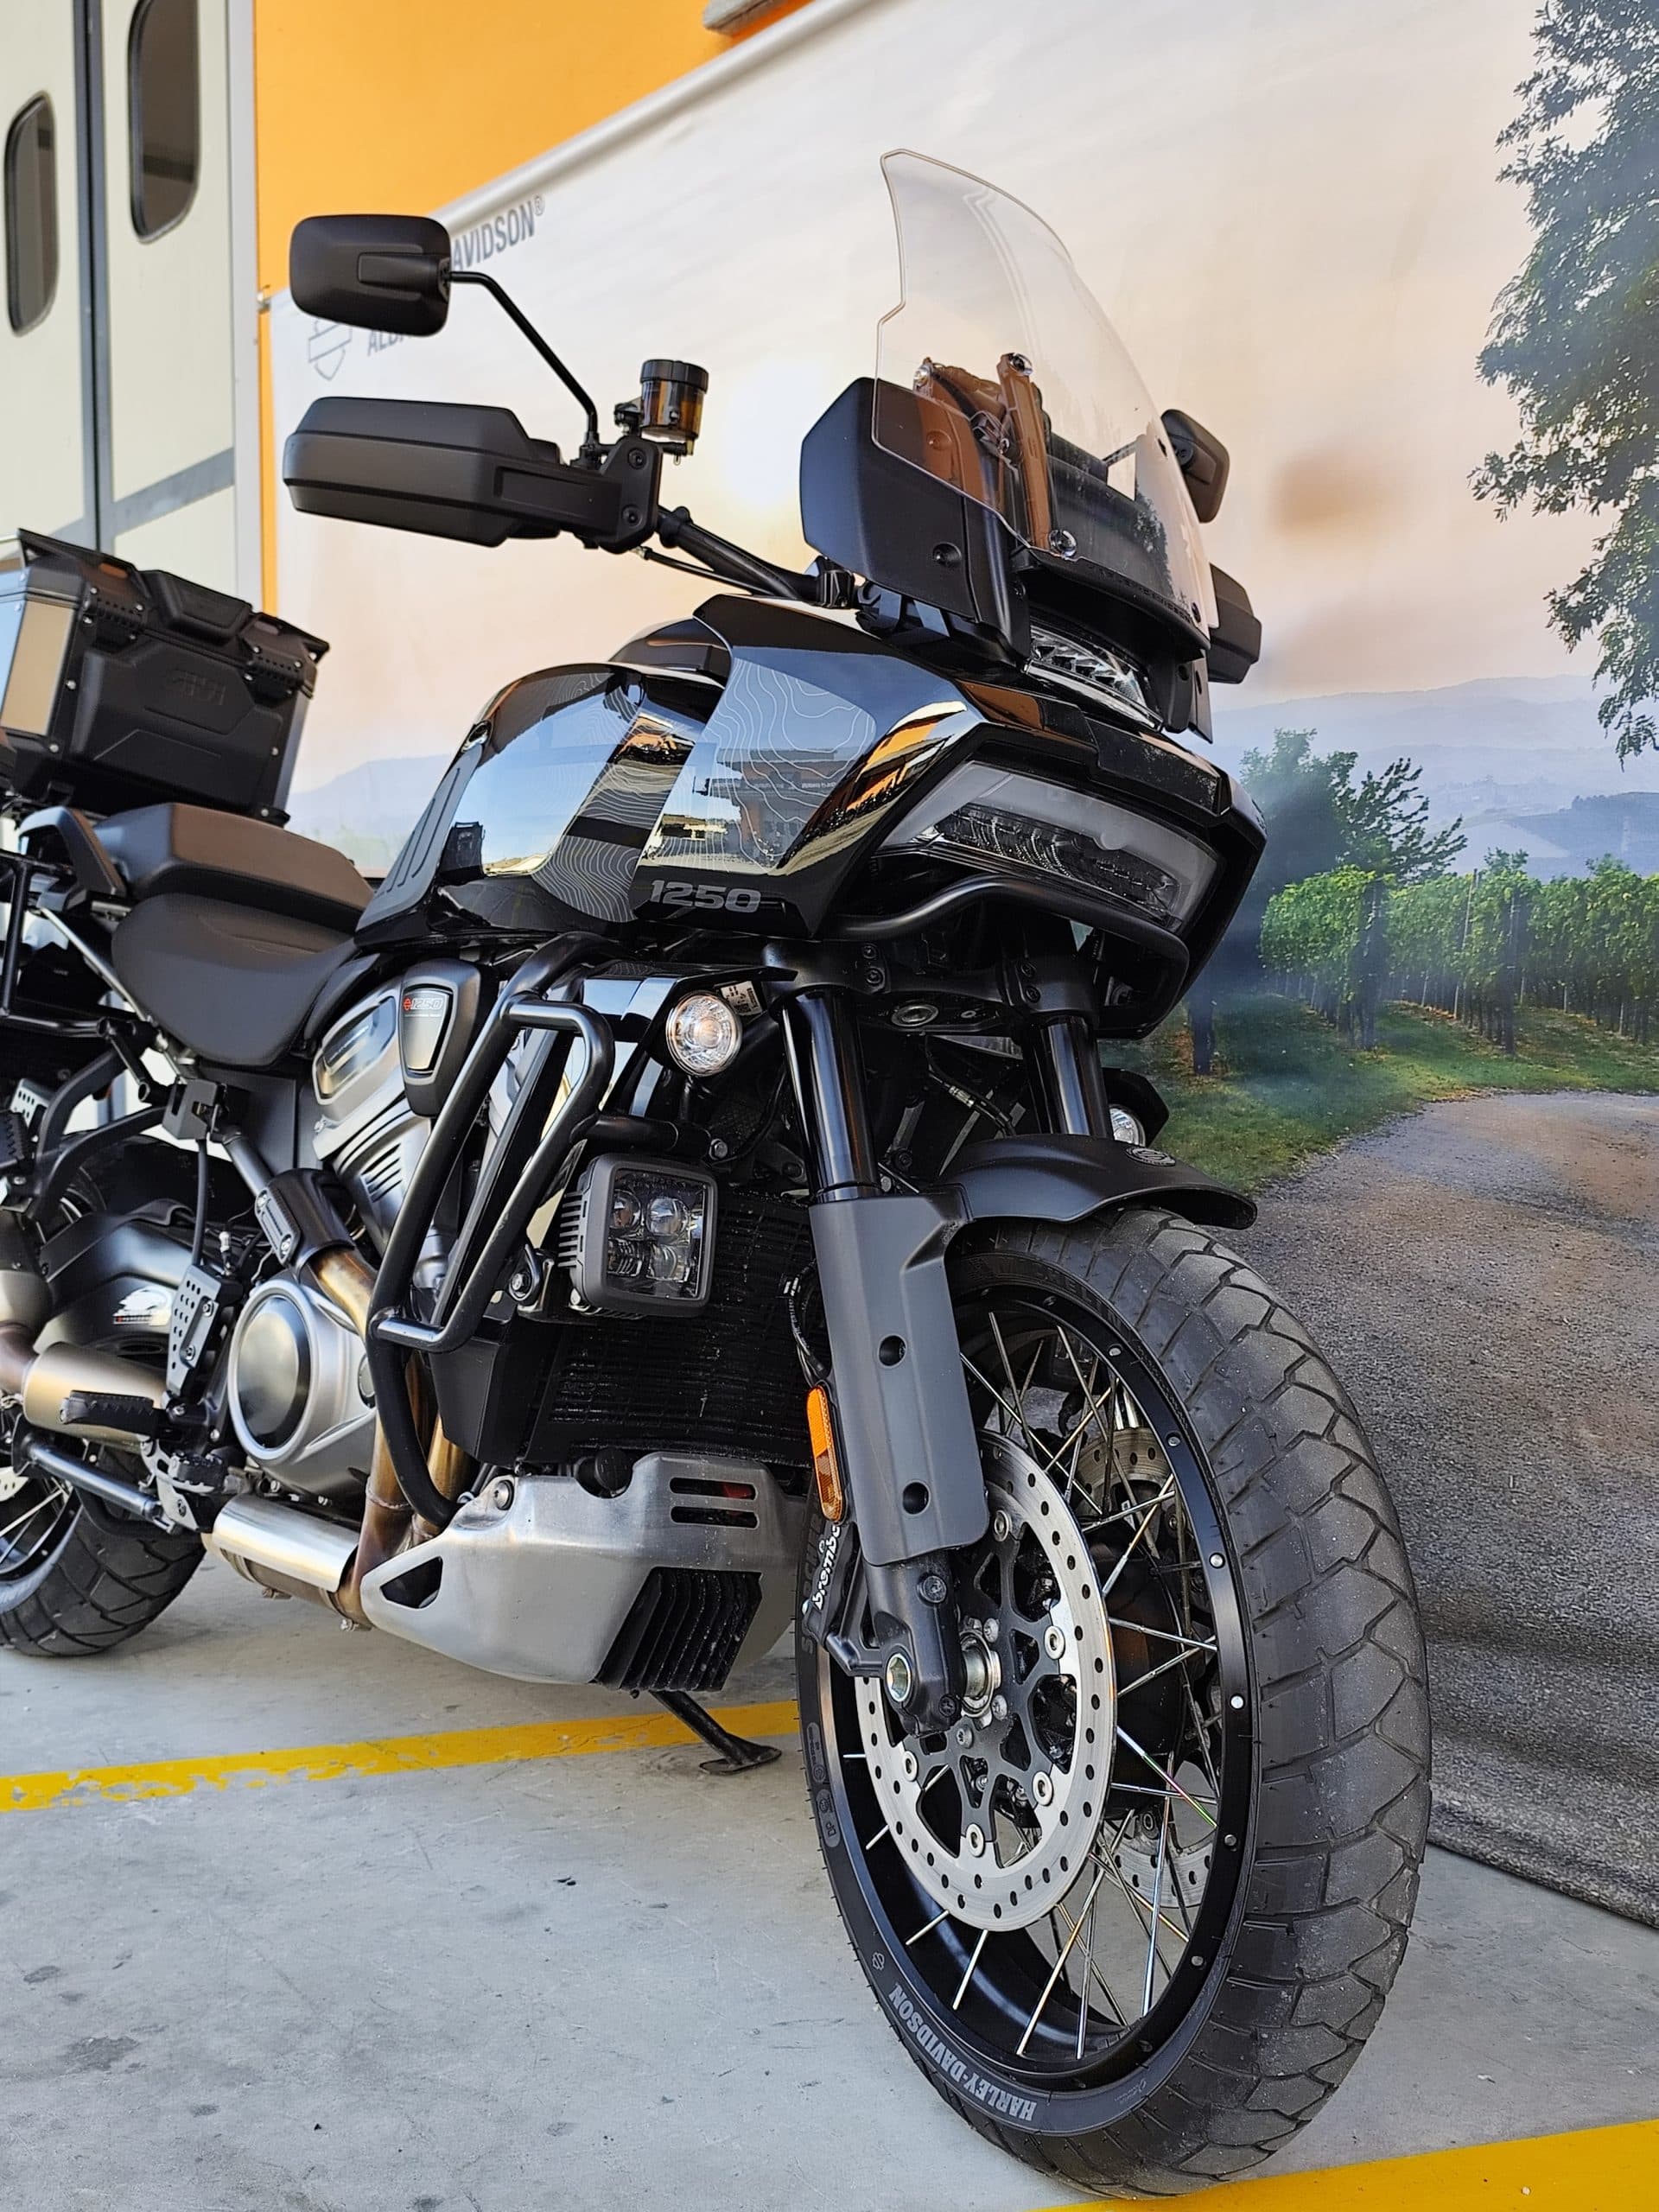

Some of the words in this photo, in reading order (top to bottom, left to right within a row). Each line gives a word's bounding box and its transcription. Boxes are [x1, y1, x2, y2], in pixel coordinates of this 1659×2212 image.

[650, 880, 761, 912] 1250
[410, 998, 442, 1010] 1250
[888, 1983, 1037, 2121] HARLEY-DAVIDSON
